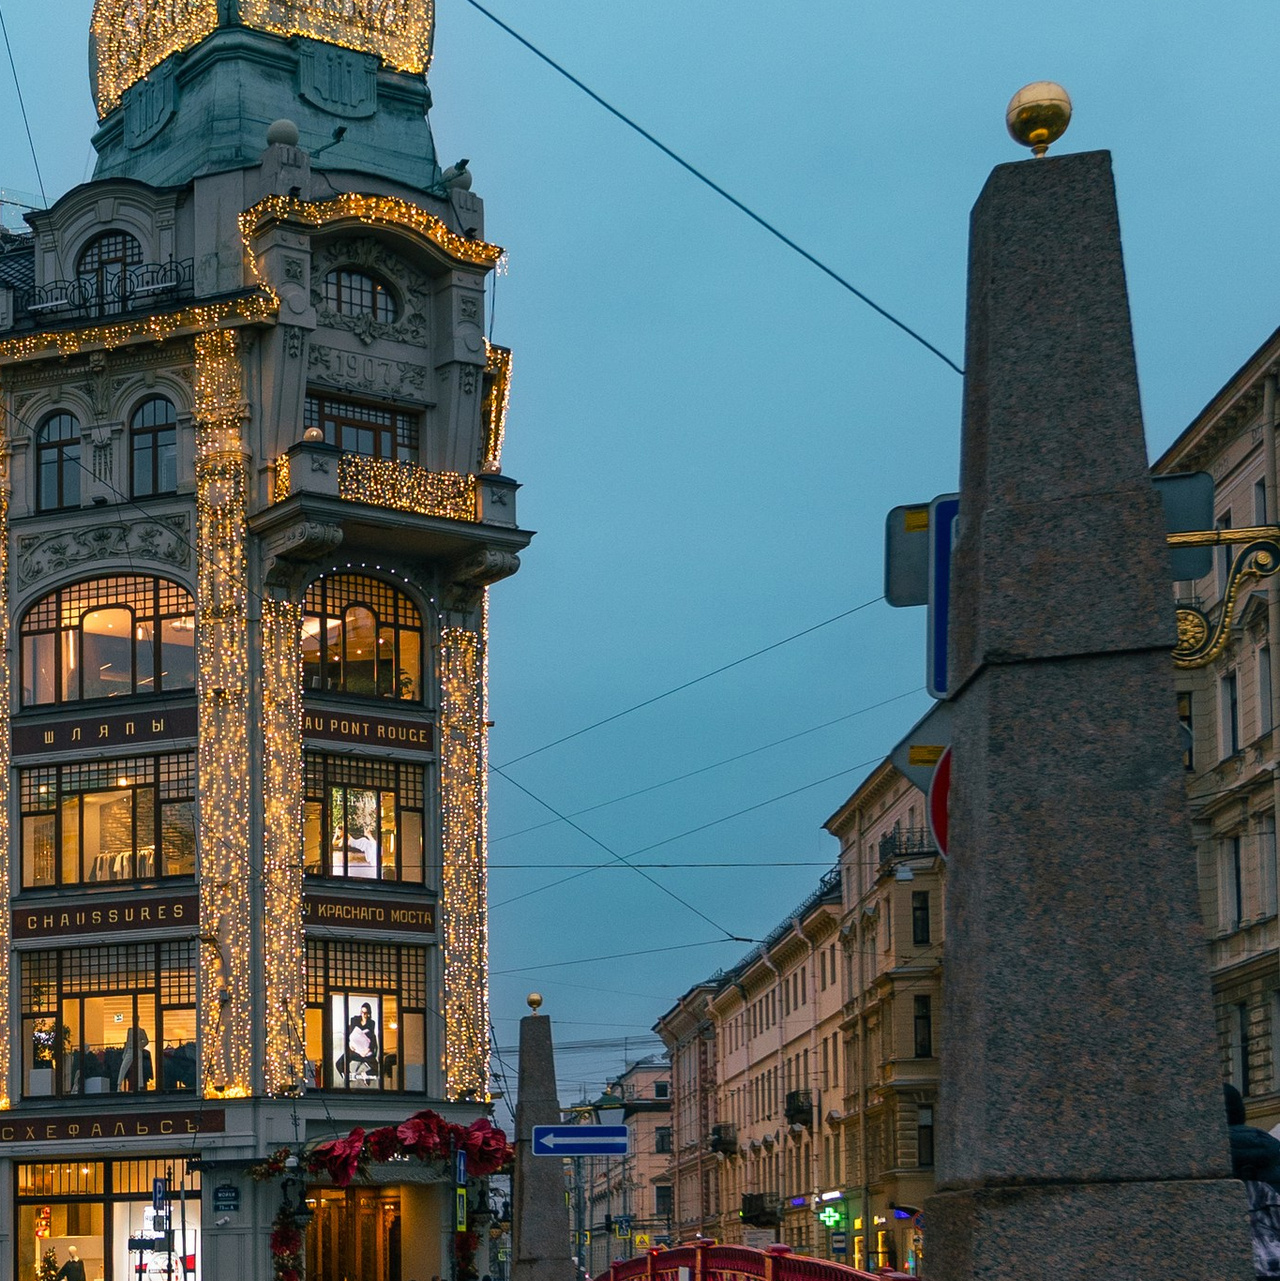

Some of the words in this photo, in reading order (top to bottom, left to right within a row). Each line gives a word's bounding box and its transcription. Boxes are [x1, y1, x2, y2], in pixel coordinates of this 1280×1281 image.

[336, 353, 392, 386] 1907
[43, 718, 165, 744] ШЛЯПЫ
[305, 716, 323, 731] AU
[330, 719, 370, 736] PONT
[377, 724, 428, 743] ROUGE
[26, 903, 184, 930] CHAUSSURES
[317, 903, 385, 921] КРАСНАГО
[390, 909, 432, 925] МОСТА
[1, 1119, 200, 1142] СХЕФАЛЬСЪ
